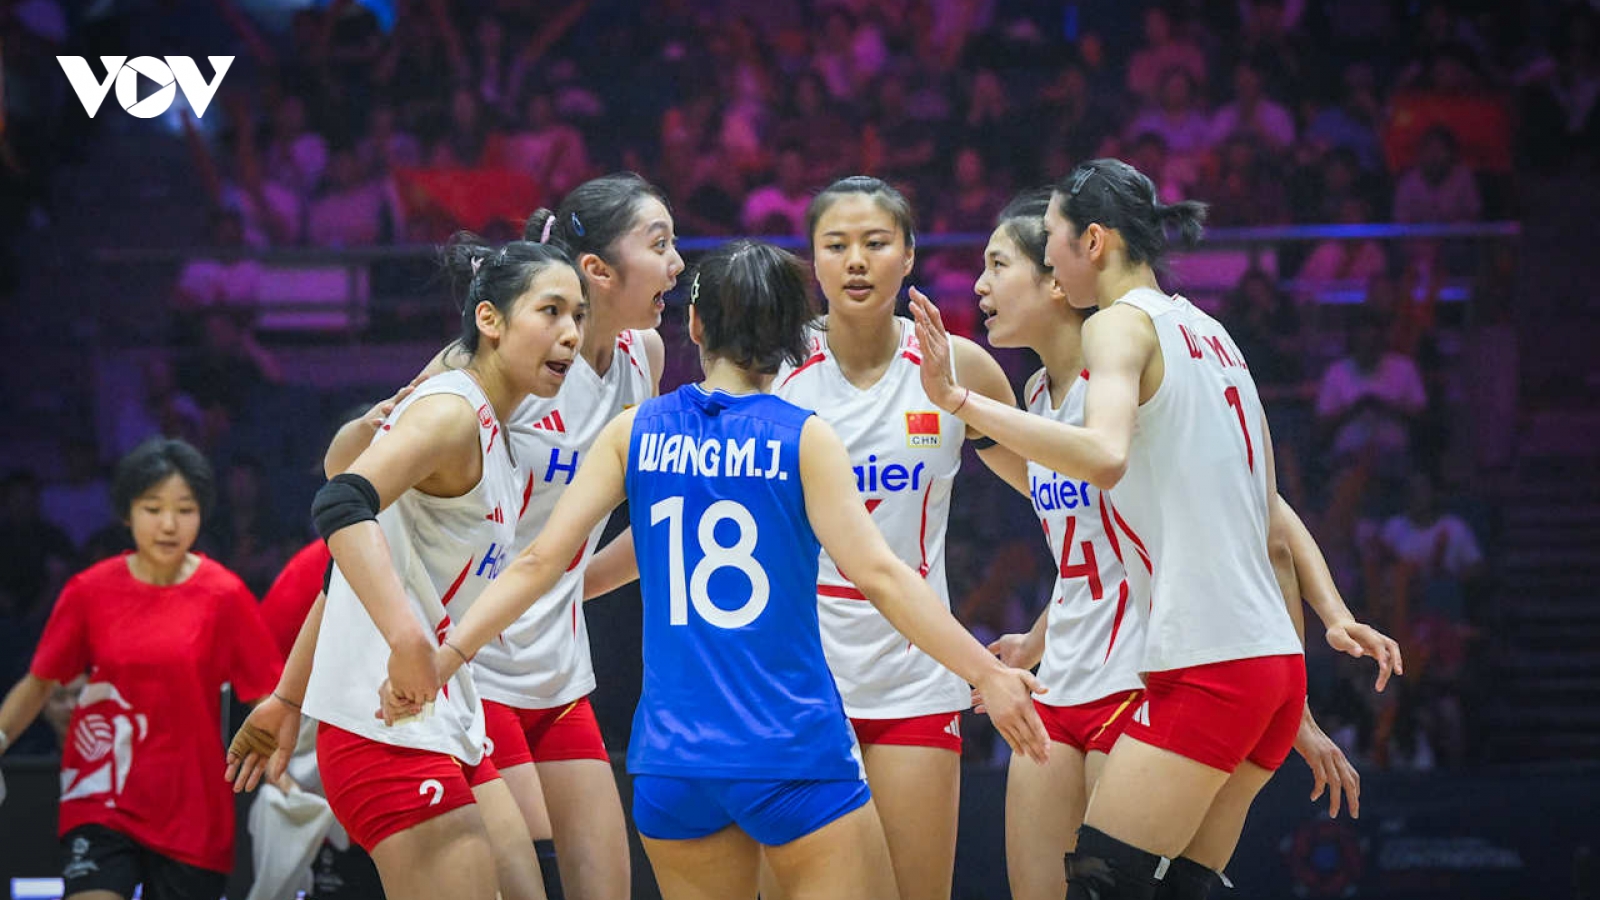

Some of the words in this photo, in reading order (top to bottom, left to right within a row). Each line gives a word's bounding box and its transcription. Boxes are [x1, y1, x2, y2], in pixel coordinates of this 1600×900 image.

[638, 432, 721, 477] WANG
[725, 437, 788, 481] M.J.
[911, 435, 938, 445] CHN
[1224, 385, 1254, 475] 1
[650, 495, 771, 629] 18
